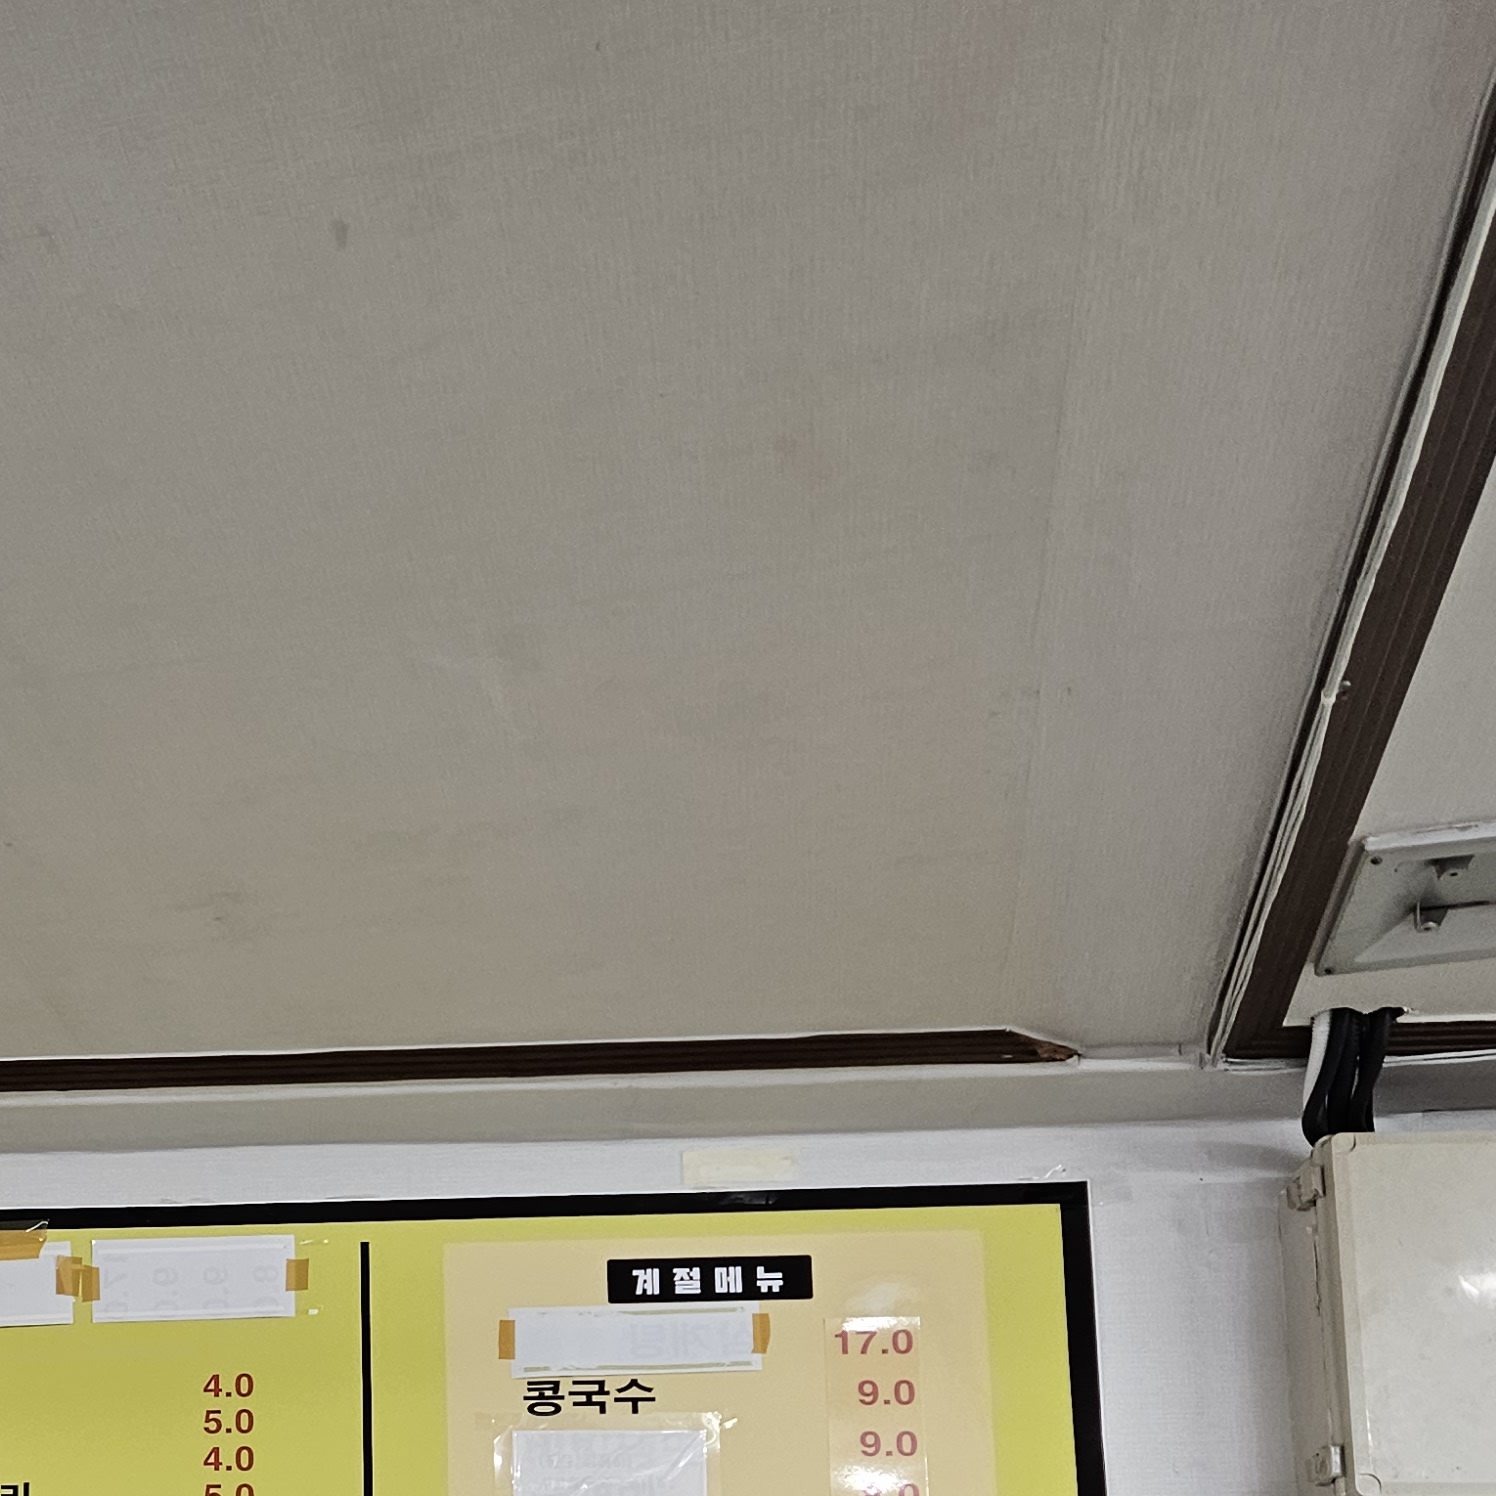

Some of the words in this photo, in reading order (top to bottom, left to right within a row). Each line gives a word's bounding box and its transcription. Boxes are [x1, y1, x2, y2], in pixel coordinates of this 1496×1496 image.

[834, 1328, 914, 1356] 17.0
[203, 1373, 255, 1398] 4.0
[522, 1378, 656, 1417] 콩국수
[856, 1378, 916, 1407] 9.0
[203, 1408, 255, 1435] 5.0
[859, 1430, 918, 1457] 9.0
[203, 1445, 255, 1472] 4.0
